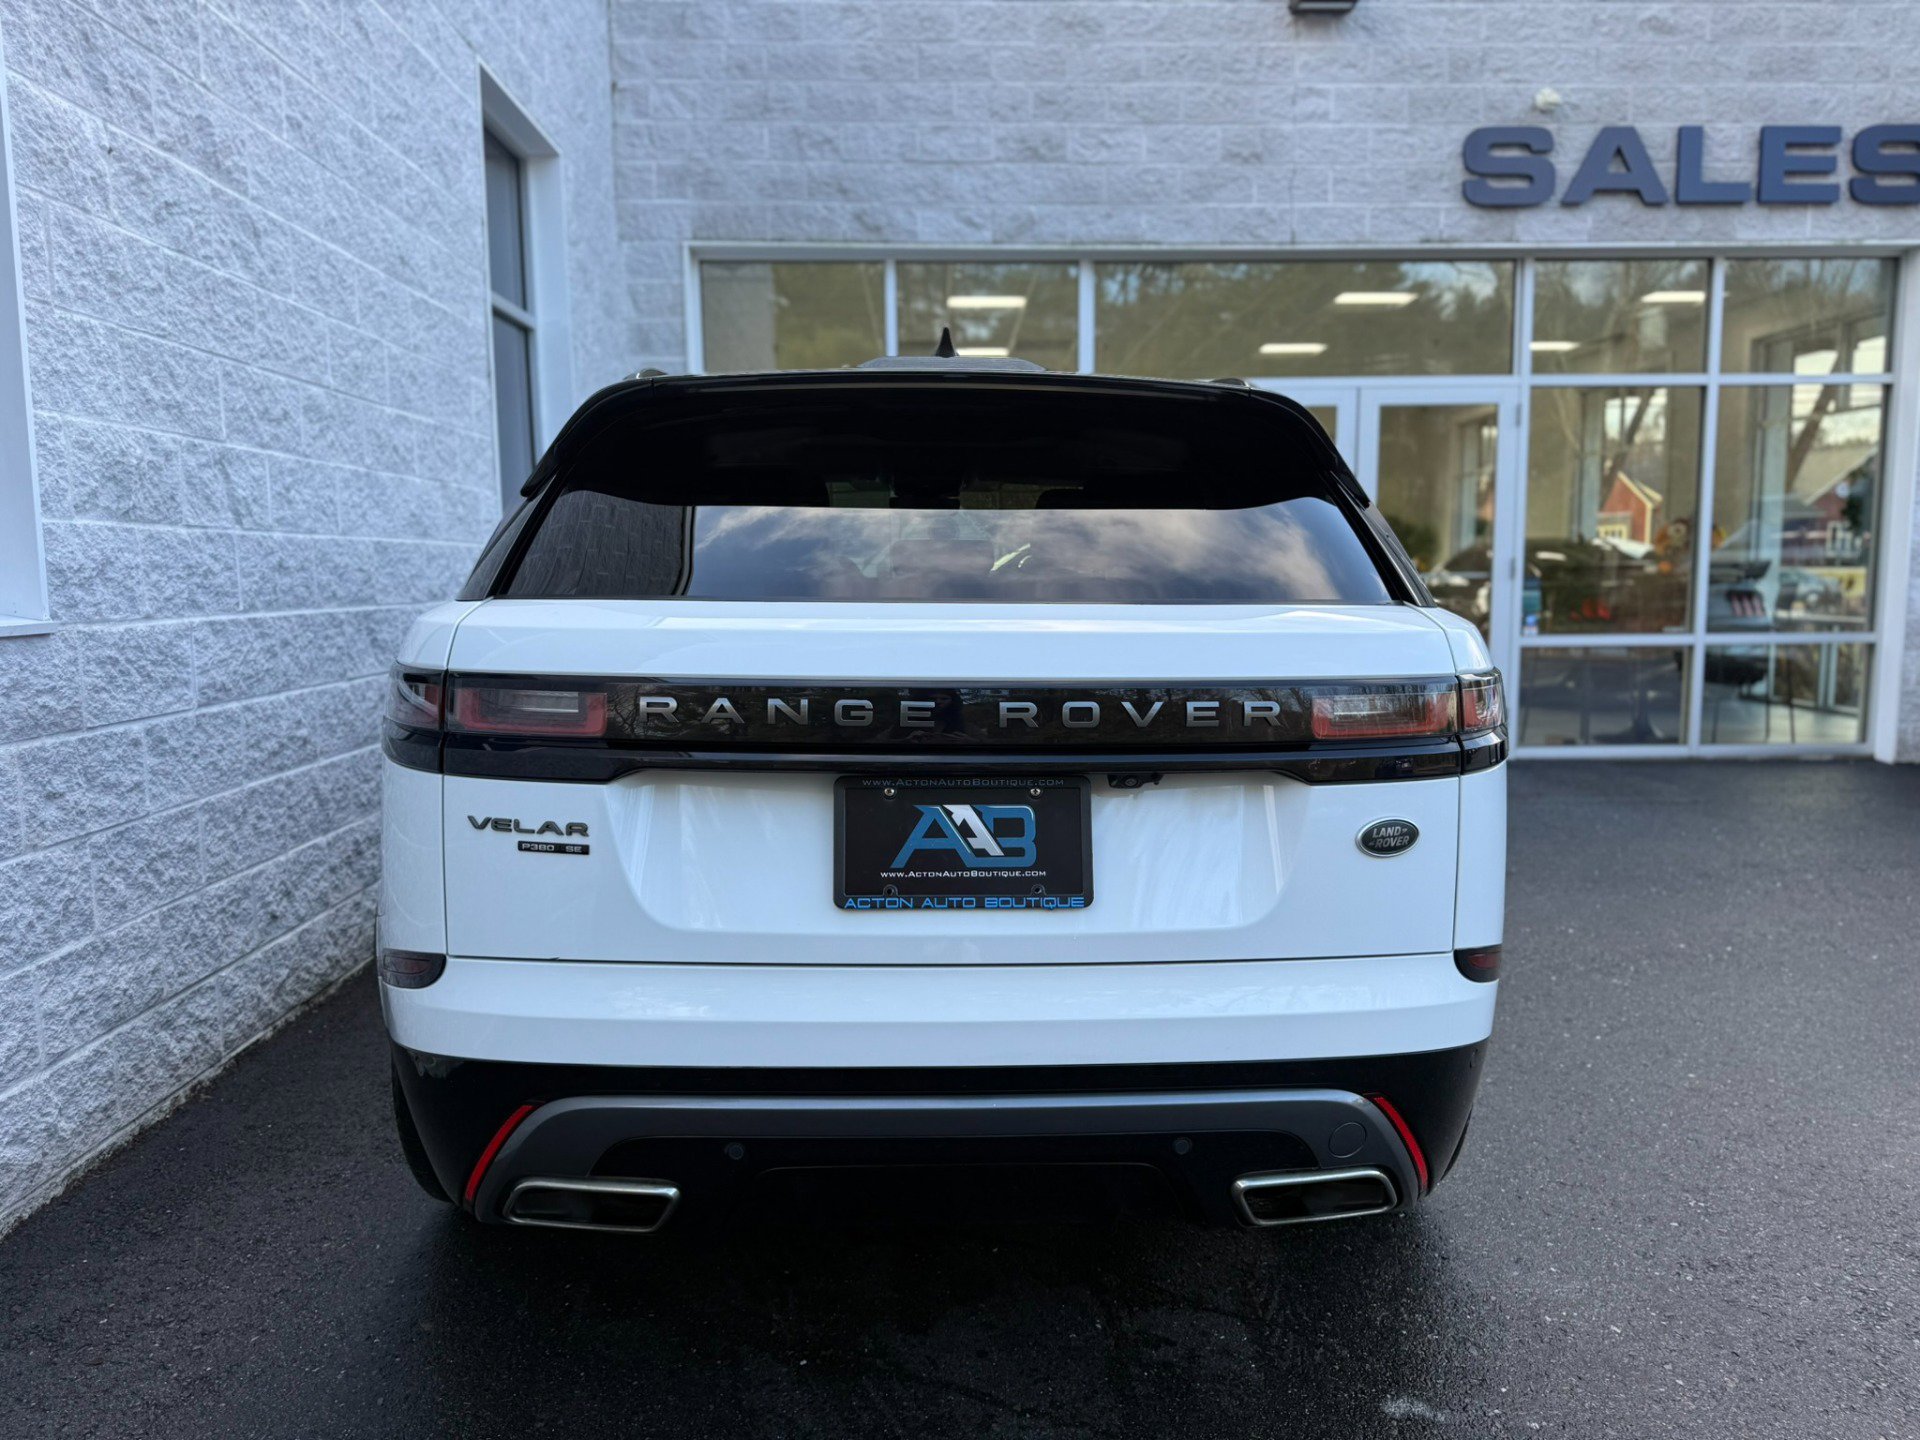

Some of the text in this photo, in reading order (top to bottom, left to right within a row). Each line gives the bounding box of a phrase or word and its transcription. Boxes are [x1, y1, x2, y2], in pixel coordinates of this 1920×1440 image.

[1462, 124, 1920, 207] SALES
[638, 695, 1283, 729] RANGE ROVER
[467, 815, 589, 837] VELAR
[1372, 826, 1401, 838] LAND
[521, 843, 583, 853] P380 SE
[1375, 835, 1410, 848] ROVER
[844, 896, 1085, 911] ACTON AUTO BOUTIQUE
